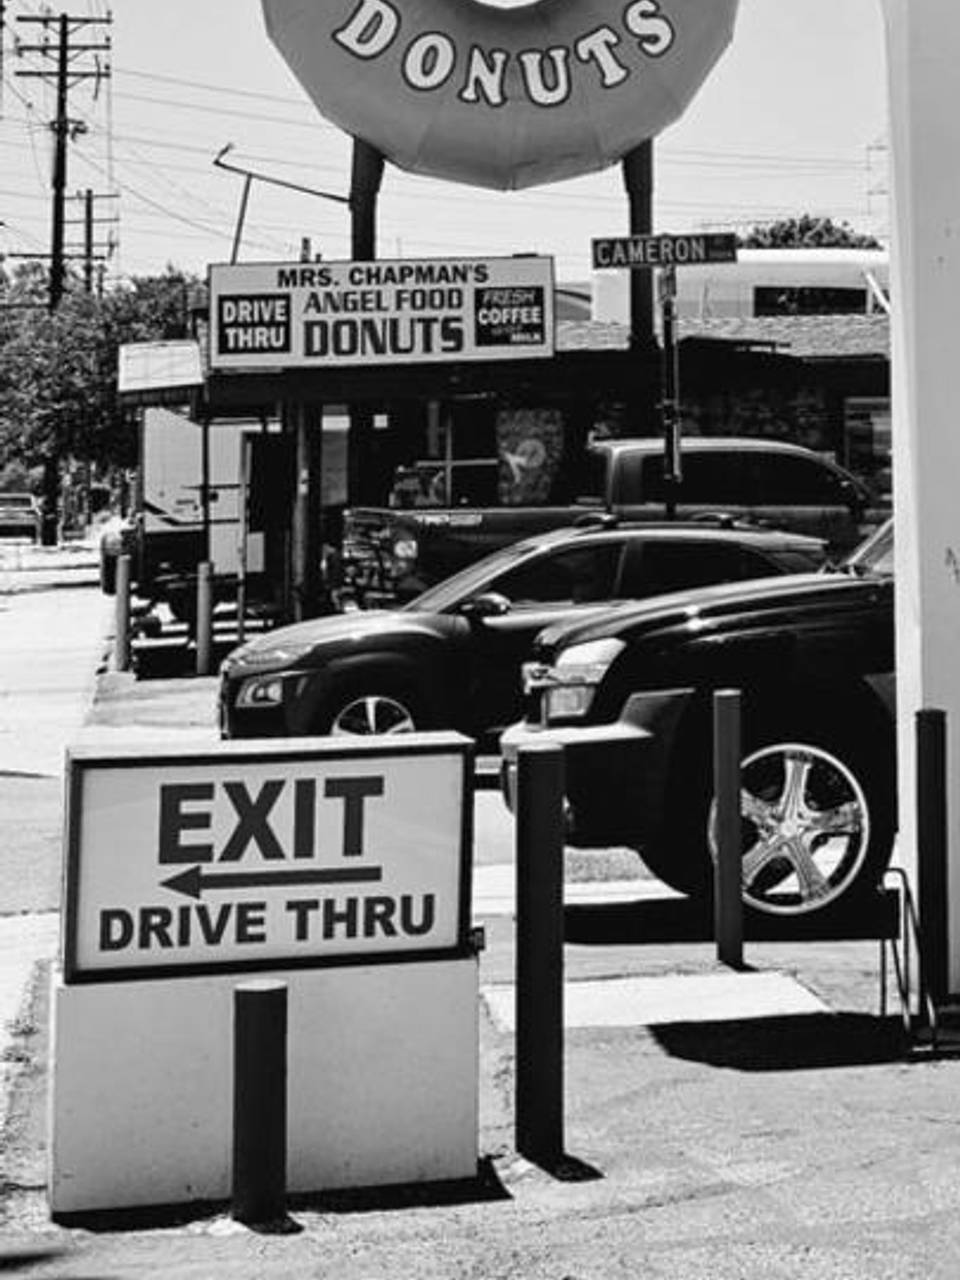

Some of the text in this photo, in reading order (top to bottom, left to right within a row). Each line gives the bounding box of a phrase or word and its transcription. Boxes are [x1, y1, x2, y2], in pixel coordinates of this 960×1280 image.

[597, 238, 706, 265] CAMERON
[277, 263, 489, 288] MRS. CHAPMAN'S
[222, 299, 288, 324] DRIVE
[303, 288, 464, 314] ANGEL FOOD
[478, 306, 542, 325] COFFEE
[225, 326, 286, 350] THRU
[303, 316, 464, 357] DONUTS
[158, 775, 385, 865] EXIT
[99, 894, 436, 952] DRIVE THRU
